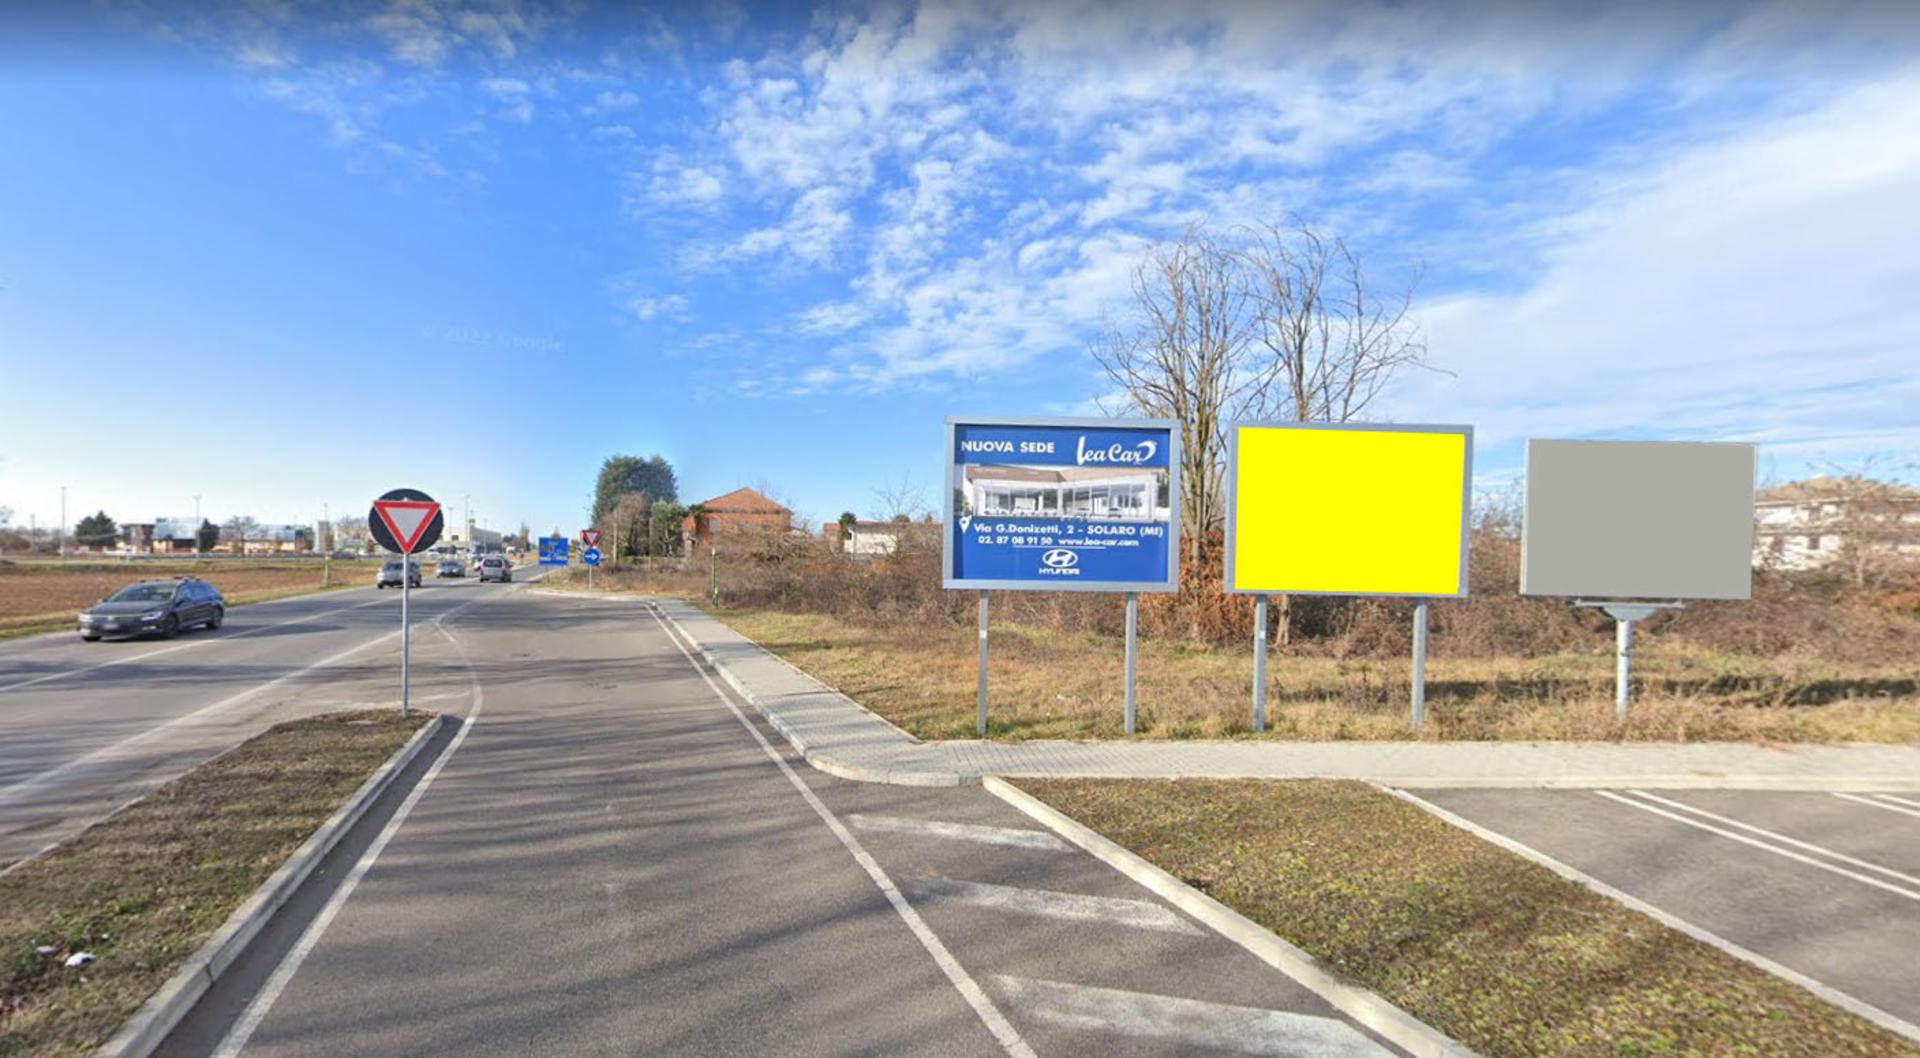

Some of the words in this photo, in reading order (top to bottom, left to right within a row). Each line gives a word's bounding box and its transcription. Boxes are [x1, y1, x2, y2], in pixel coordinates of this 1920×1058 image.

[960, 440, 1014, 453] NUOVA
[1020, 441, 1055, 453] SEDE
[974, 523, 992, 533] Via
[1067, 525, 1074, 534] 2
[1087, 525, 1136, 535] SOLARO
[1140, 526, 1163, 538] (MI)
[996, 536, 1009, 545] 87
[1011, 536, 1024, 545] 08
[1038, 567, 1080, 575] HYUNDAI
